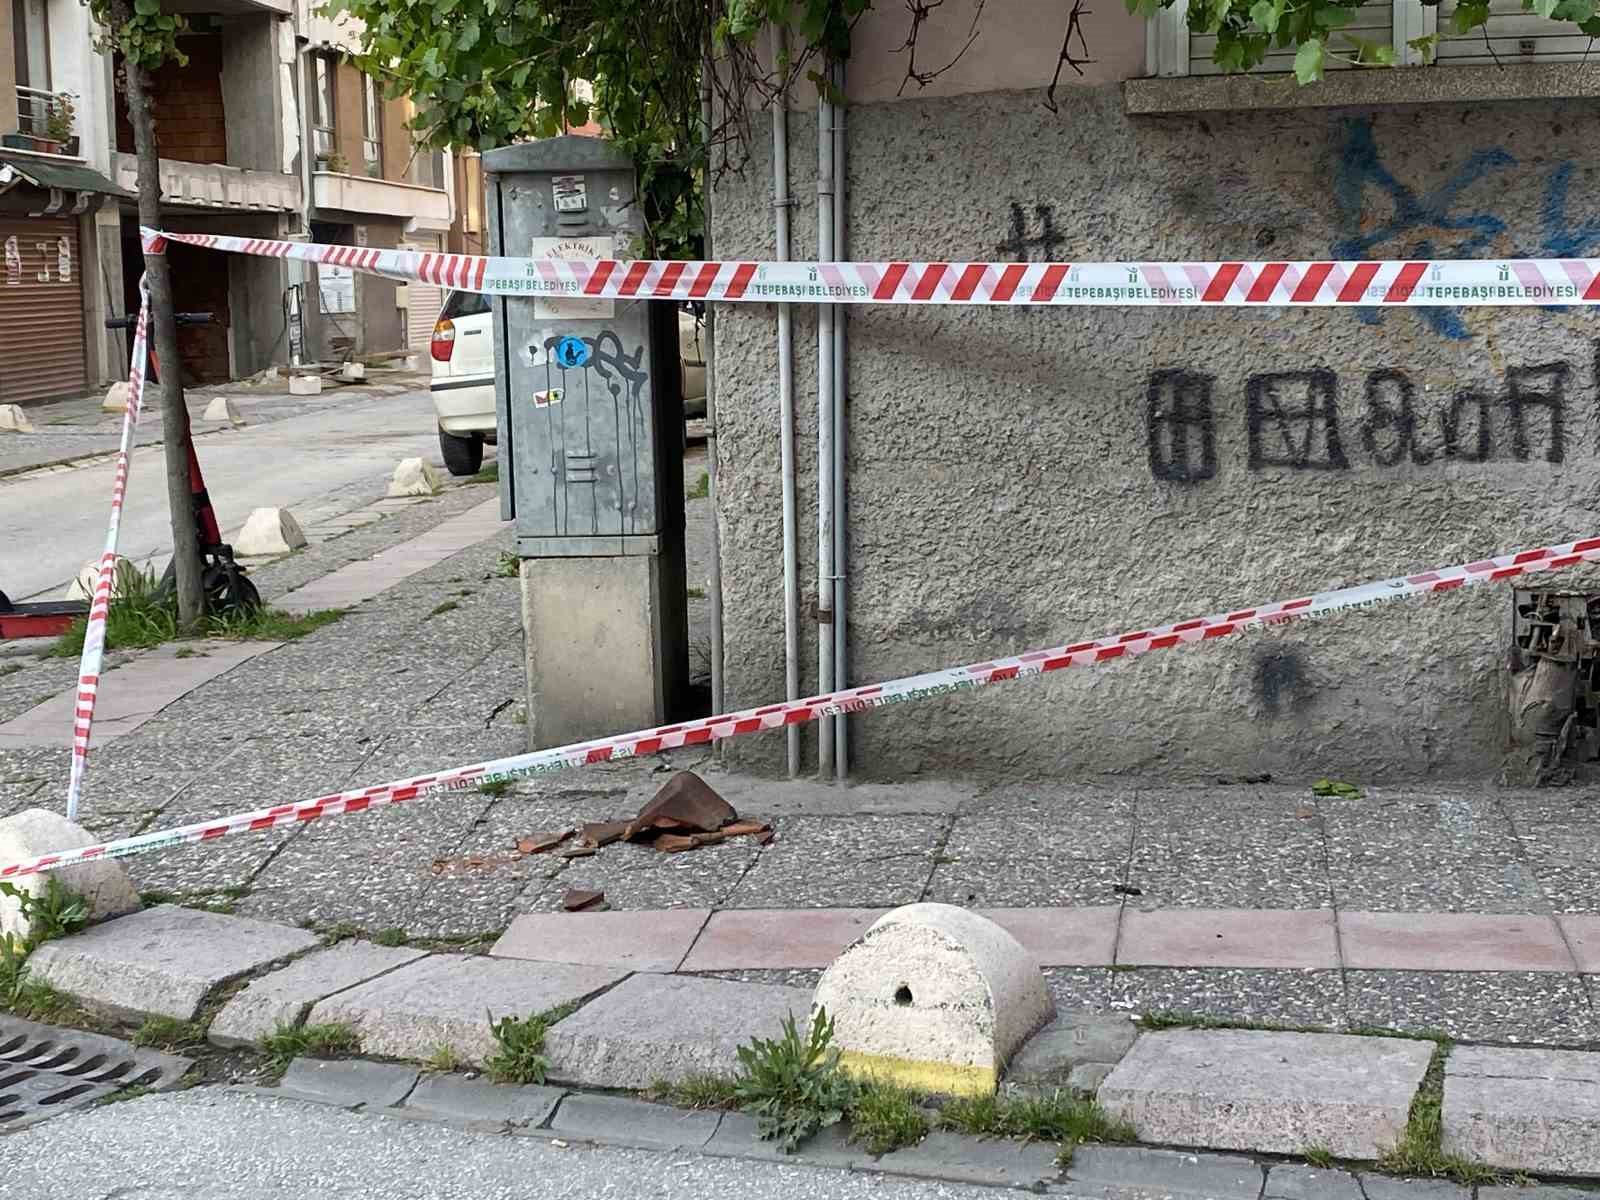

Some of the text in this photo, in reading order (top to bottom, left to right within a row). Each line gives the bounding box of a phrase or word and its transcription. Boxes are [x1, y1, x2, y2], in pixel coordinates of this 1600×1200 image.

[756, 284, 805, 298] TEPEBAŞI
[1067, 285, 1198, 300] TEPEBAŞI BELEDİYESİ
[1428, 284, 1578, 300] TEPEBAŞI BELEDİYESİ
